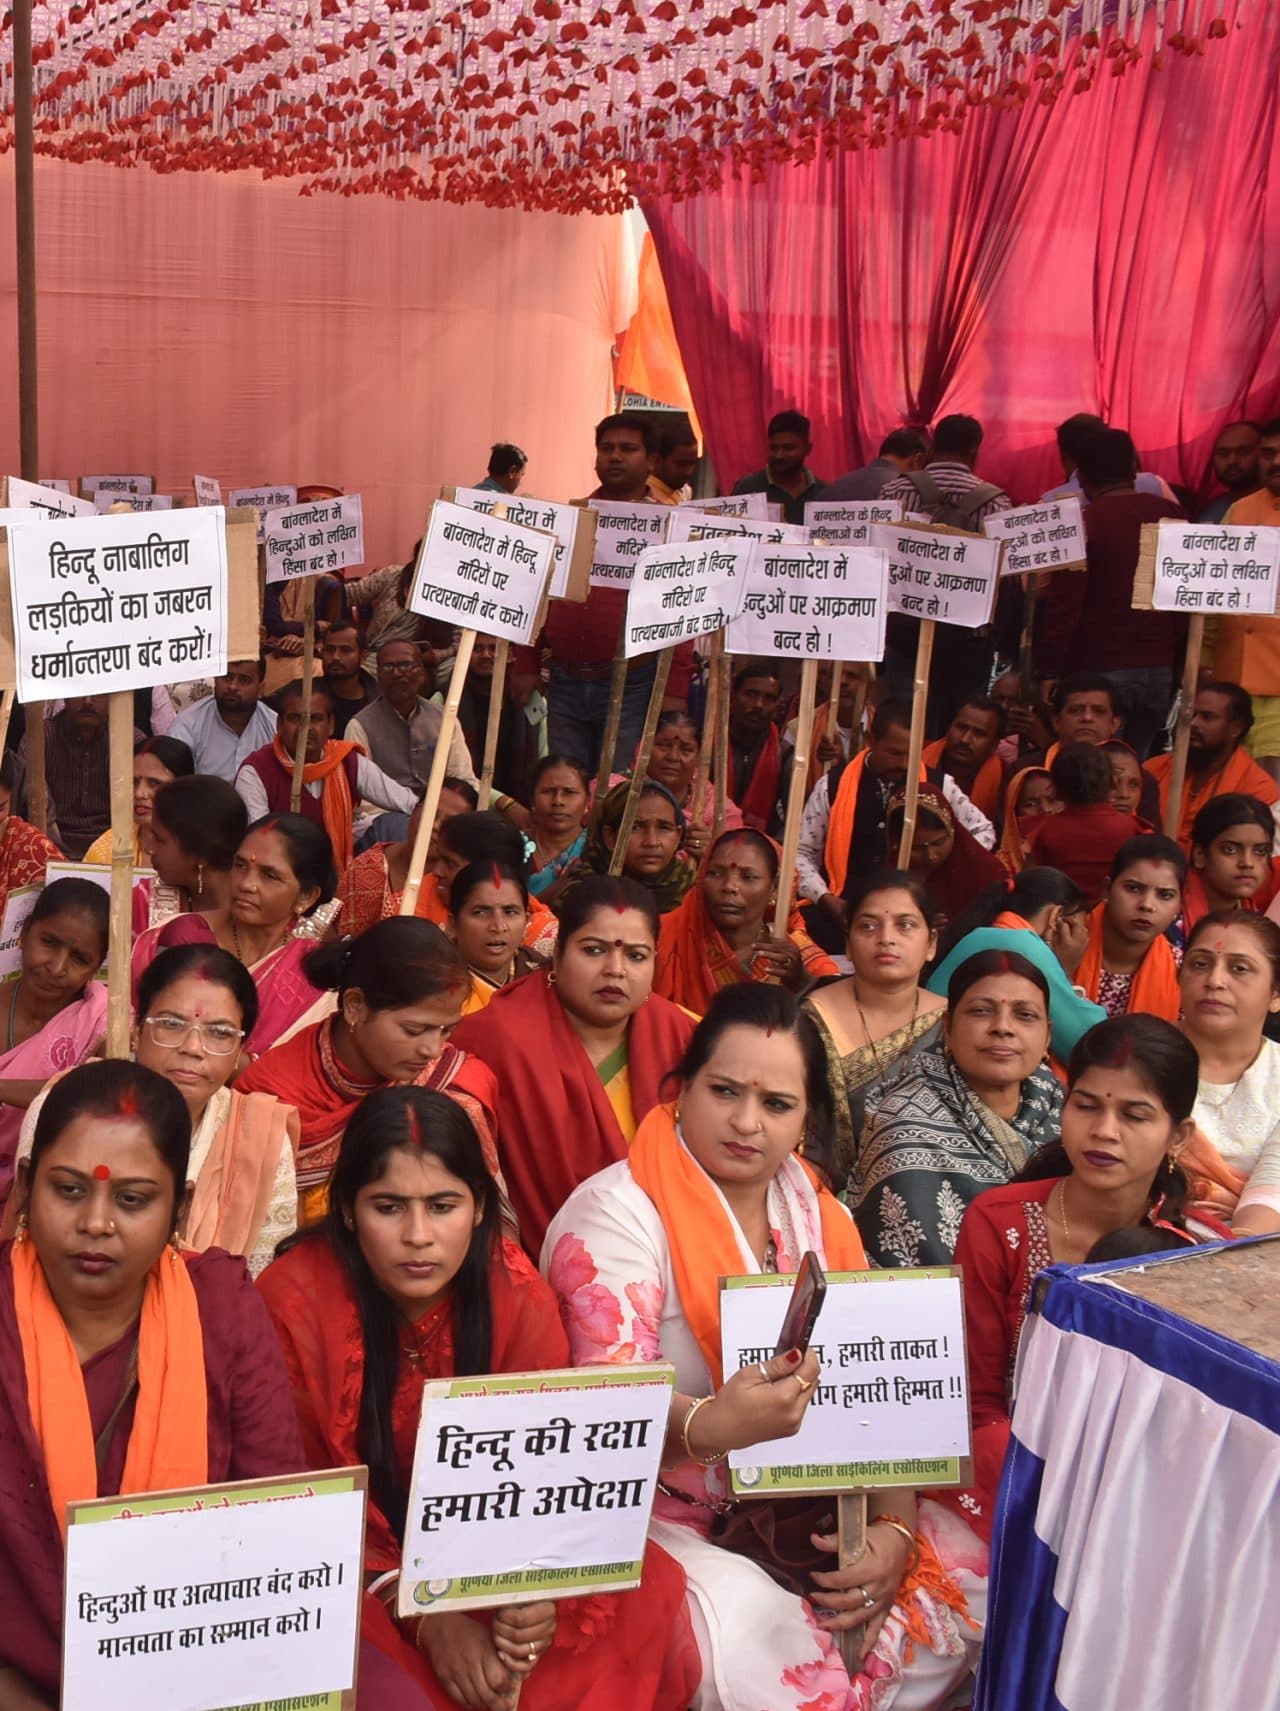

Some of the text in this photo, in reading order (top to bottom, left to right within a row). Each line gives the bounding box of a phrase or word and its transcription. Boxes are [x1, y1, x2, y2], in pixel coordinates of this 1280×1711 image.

[280, 505, 329, 530] बांग्लादेश
[1004, 508, 1048, 530] बांग्लादेश
[308, 524, 357, 546] को लक्षित
[1049, 524, 1078, 543] लक्षित
[1182, 530, 1258, 552] बांग्लादेश में
[48, 532, 190, 585] हिन्दू नाबालिग
[443, 521, 495, 554] बांग्लादेश
[511, 540, 538, 575] हिन्दू
[897, 537, 950, 562] बांग्लादेश
[954, 540, 967, 563] में
[457, 558, 509, 592] मंदिरों पर
[644, 555, 694, 581] बांग्लादेश
[765, 551, 848, 580] बांग्लादेश में
[1162, 556, 1272, 583] हिन्दुओं को लक्षित
[915, 568, 931, 587] पर
[933, 572, 988, 595] आक्रमण
[421, 582, 479, 616] पत्थरबाजी
[789, 594, 806, 614] पर
[812, 593, 876, 619] आक्रमण
[901, 592, 939, 616] बन्द हो
[1175, 586, 1242, 608] हिंसा बंद हो
[27, 585, 214, 638] लड़कियों का जबरन
[631, 615, 684, 643] पत्थरबाजी
[774, 624, 820, 652] बन्द हो
[31, 640, 132, 680] धर्मान्तरण
[138, 634, 164, 668] बंद
[838, 1336, 885, 1369] हमारी
[889, 1338, 938, 1361] ताकत
[842, 1377, 889, 1408] हमारी
[894, 1375, 945, 1402] हिम्मत
[437, 1417, 653, 1472] हिन्दू की रक्षा
[420, 1475, 648, 1532] हमारी अपेक्षा
[78, 1567, 294, 1623] हिन्दुओं पर अत्याचार बंद
[97, 1630, 175, 1659] मानवता
[178, 1627, 206, 1650] का
